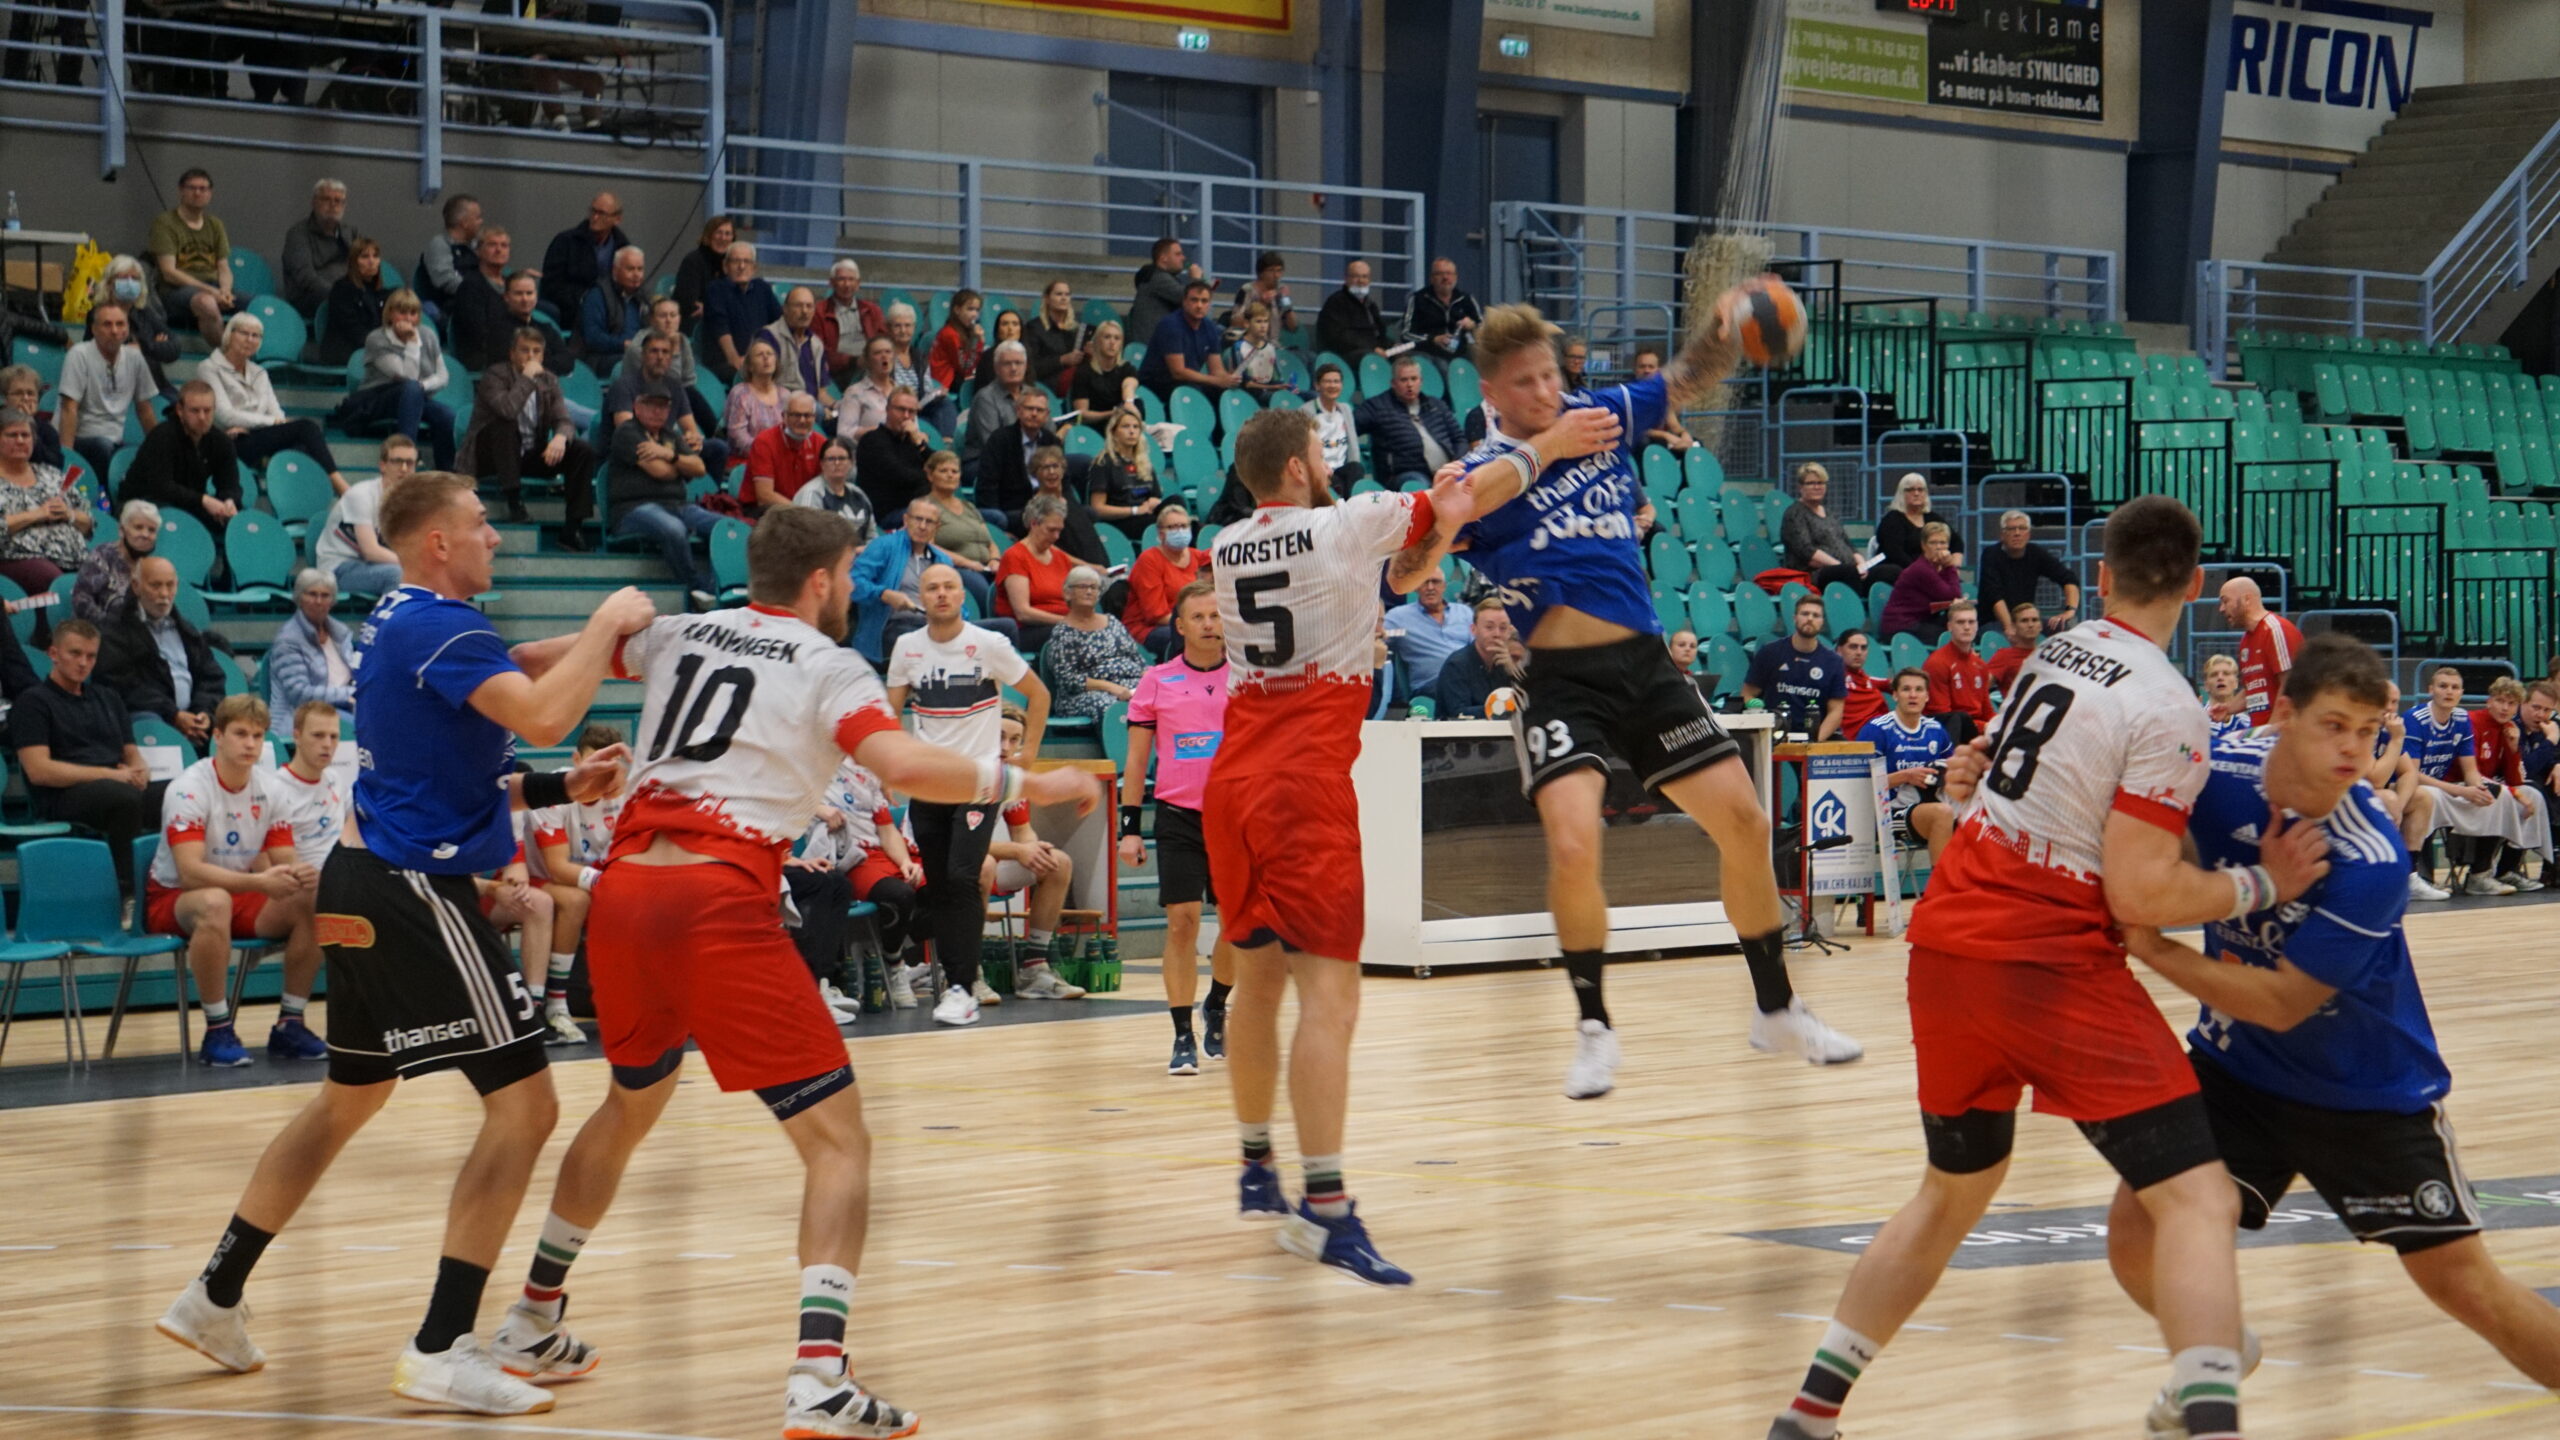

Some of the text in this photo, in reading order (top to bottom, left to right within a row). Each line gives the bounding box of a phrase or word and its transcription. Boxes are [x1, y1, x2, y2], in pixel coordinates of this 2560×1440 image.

[1984, 6, 2099, 42] reklame
[1972, 51, 2023, 79] skaber
[2027, 59, 2099, 87] SYNLIGHED
[1939, 80, 2100, 113] Se mere på bsm-reklame.dk
[1217, 528, 1314, 568] MORSTEN
[1235, 570, 1295, 668] 5
[647, 652, 756, 763] 10
[1776, 680, 1820, 698] thansen
[1526, 719, 1575, 767] 93
[1985, 672, 2076, 801] 18
[506, 971, 546, 1021] 5
[382, 1016, 480, 1054] thansen
